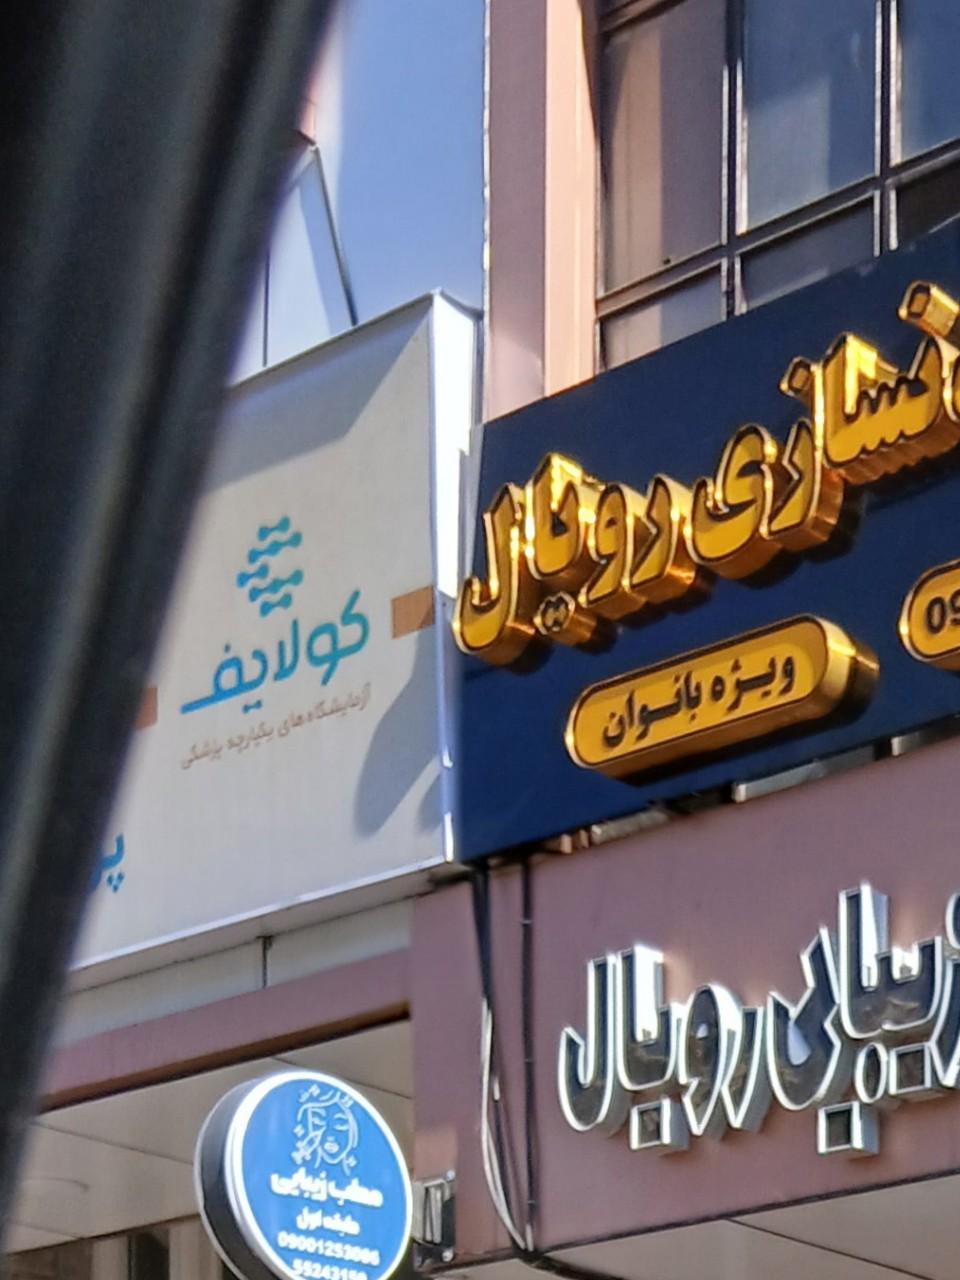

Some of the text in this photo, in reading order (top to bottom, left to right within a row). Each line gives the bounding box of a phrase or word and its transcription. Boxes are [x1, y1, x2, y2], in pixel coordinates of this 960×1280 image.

[453, 452, 690, 655] رویال
[180, 588, 371, 714] کولایف
[602, 655, 795, 748] ویژه بانوان
[558, 944, 766, 1150] رویال
